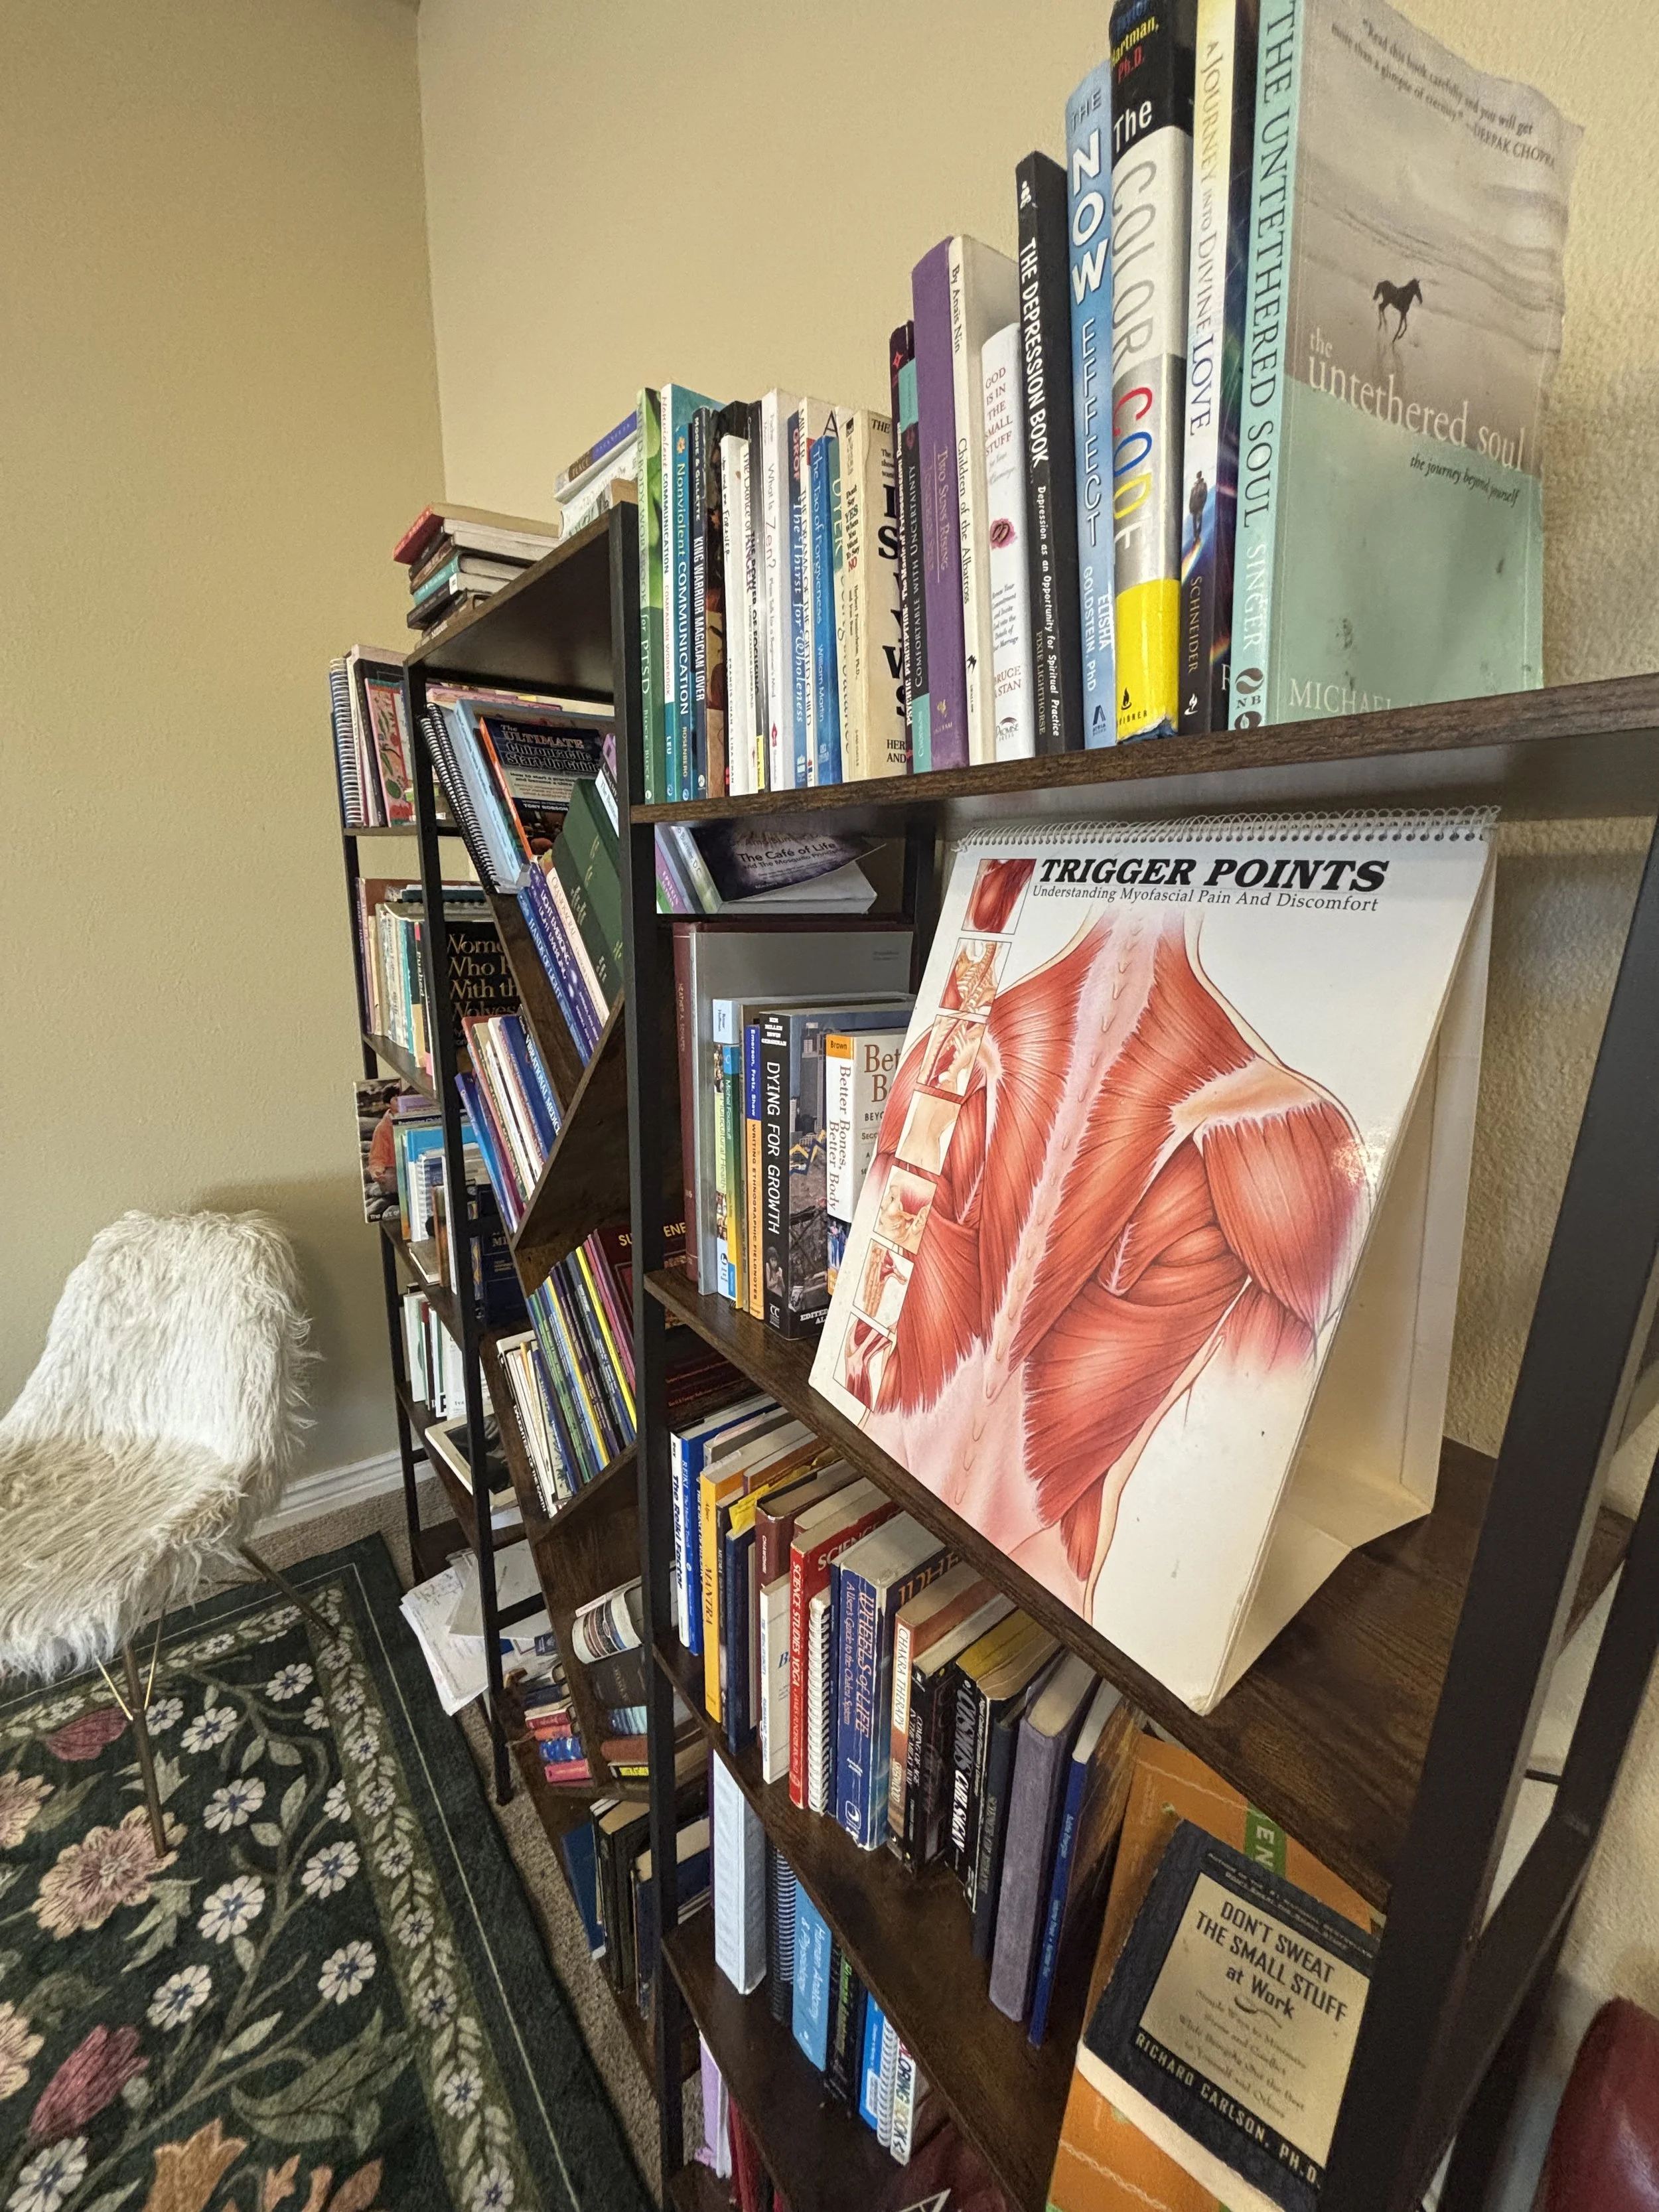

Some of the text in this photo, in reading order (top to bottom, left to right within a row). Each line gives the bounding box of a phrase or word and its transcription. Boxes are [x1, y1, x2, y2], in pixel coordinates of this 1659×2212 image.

[1114, 100, 1152, 153] The
[1498, 113, 1516, 130] will
[1516, 121, 1534, 137] get
[1190, 41, 1223, 436] A JOURNEY INTO DIVINE LOVE
[1244, 0, 1295, 528] THE UNTETHERED SOUL
[952, 264, 960, 284] By
[954, 325, 962, 353] Nin
[1071, 88, 1109, 548] THE NOW EFFECT
[1309, 328, 1333, 358] the
[985, 366, 1007, 389] GOD
[1019, 237, 1049, 469] THE DEPRESSION BOOK
[872, 419, 891, 434] THE
[985, 415, 1013, 441] SMALL
[987, 400, 1007, 421] THE
[1309, 356, 1526, 473] untethered soul
[813, 446, 822, 479] The
[985, 430, 1013, 457] STUFF
[1112, 386, 1153, 550] CODE
[1425, 457, 1490, 494] journey beyond
[908, 465, 918, 556] UNCERTAINTY
[956, 437, 973, 605] Children the Albatross
[765, 516, 776, 569] Zen?
[676, 463, 689, 715] Nonviolent COMMUNICATION
[1036, 486, 1060, 737] Depression as an Opportunity for Spiritual Practice
[1243, 542, 1267, 652] SINGER
[693, 536, 705, 701] KING WARRIOR LOVER
[913, 599, 923, 688] COMFORTABLE
[1098, 589, 1110, 651] ELISHA
[1189, 576, 1202, 674] SCHNEIDER
[641, 639, 650, 694] PTSD
[795, 631, 806, 723] Wholeness
[1087, 659, 1096, 692] PhD
[1037, 663, 1045, 735] LIGHTHORSE
[502, 731, 585, 749] ULTIMATE
[506, 739, 593, 761] Chiropractic
[506, 753, 564, 771] Start-Up
[738, 841, 837, 863] The Café of Life
[760, 860, 774, 869] The
[1040, 858, 1390, 892] TRIGGER POINTS
[1033, 885, 1378, 911] Understanding Myofascial Pain And Discomfort
[529, 917, 563, 999] HANDS LIGHT
[526, 1035, 549, 1100] VIBRATIONAL
[830, 1040, 847, 1050] Brown
[766, 1061, 780, 1116] DYING
[767, 1123, 780, 1157] FOR
[839, 1064, 851, 1171] Better Bones,
[828, 1120, 840, 1211] Better Body
[767, 1164, 780, 1234] GROWTH
[536, 1486, 547, 1512] EARTH
[703, 1564, 713, 1627] MANTRA
[792, 1560, 802, 1608] SCIENCE
[792, 1609, 802, 1656] STUDIES
[844, 1581, 855, 1697] A the Chakra
[792, 1655, 801, 1687] YOGA
[855, 1591, 875, 1739] WHEELS LIFE
[895, 1627, 910, 1732] CHAKRA THERAPY
[952, 1805, 967, 1854] SAGAN
[798, 1928, 810, 1997] Physiology
[809, 1923, 826, 2021] Human Anatomy
[1196, 1910, 1348, 2023] THE SMALL STUFF
[1275, 1933, 1335, 1983] SWEAT
[1226, 1966, 1295, 2020] at Work
[1135, 2032, 1322, 2190] RICHARD PH.D.
